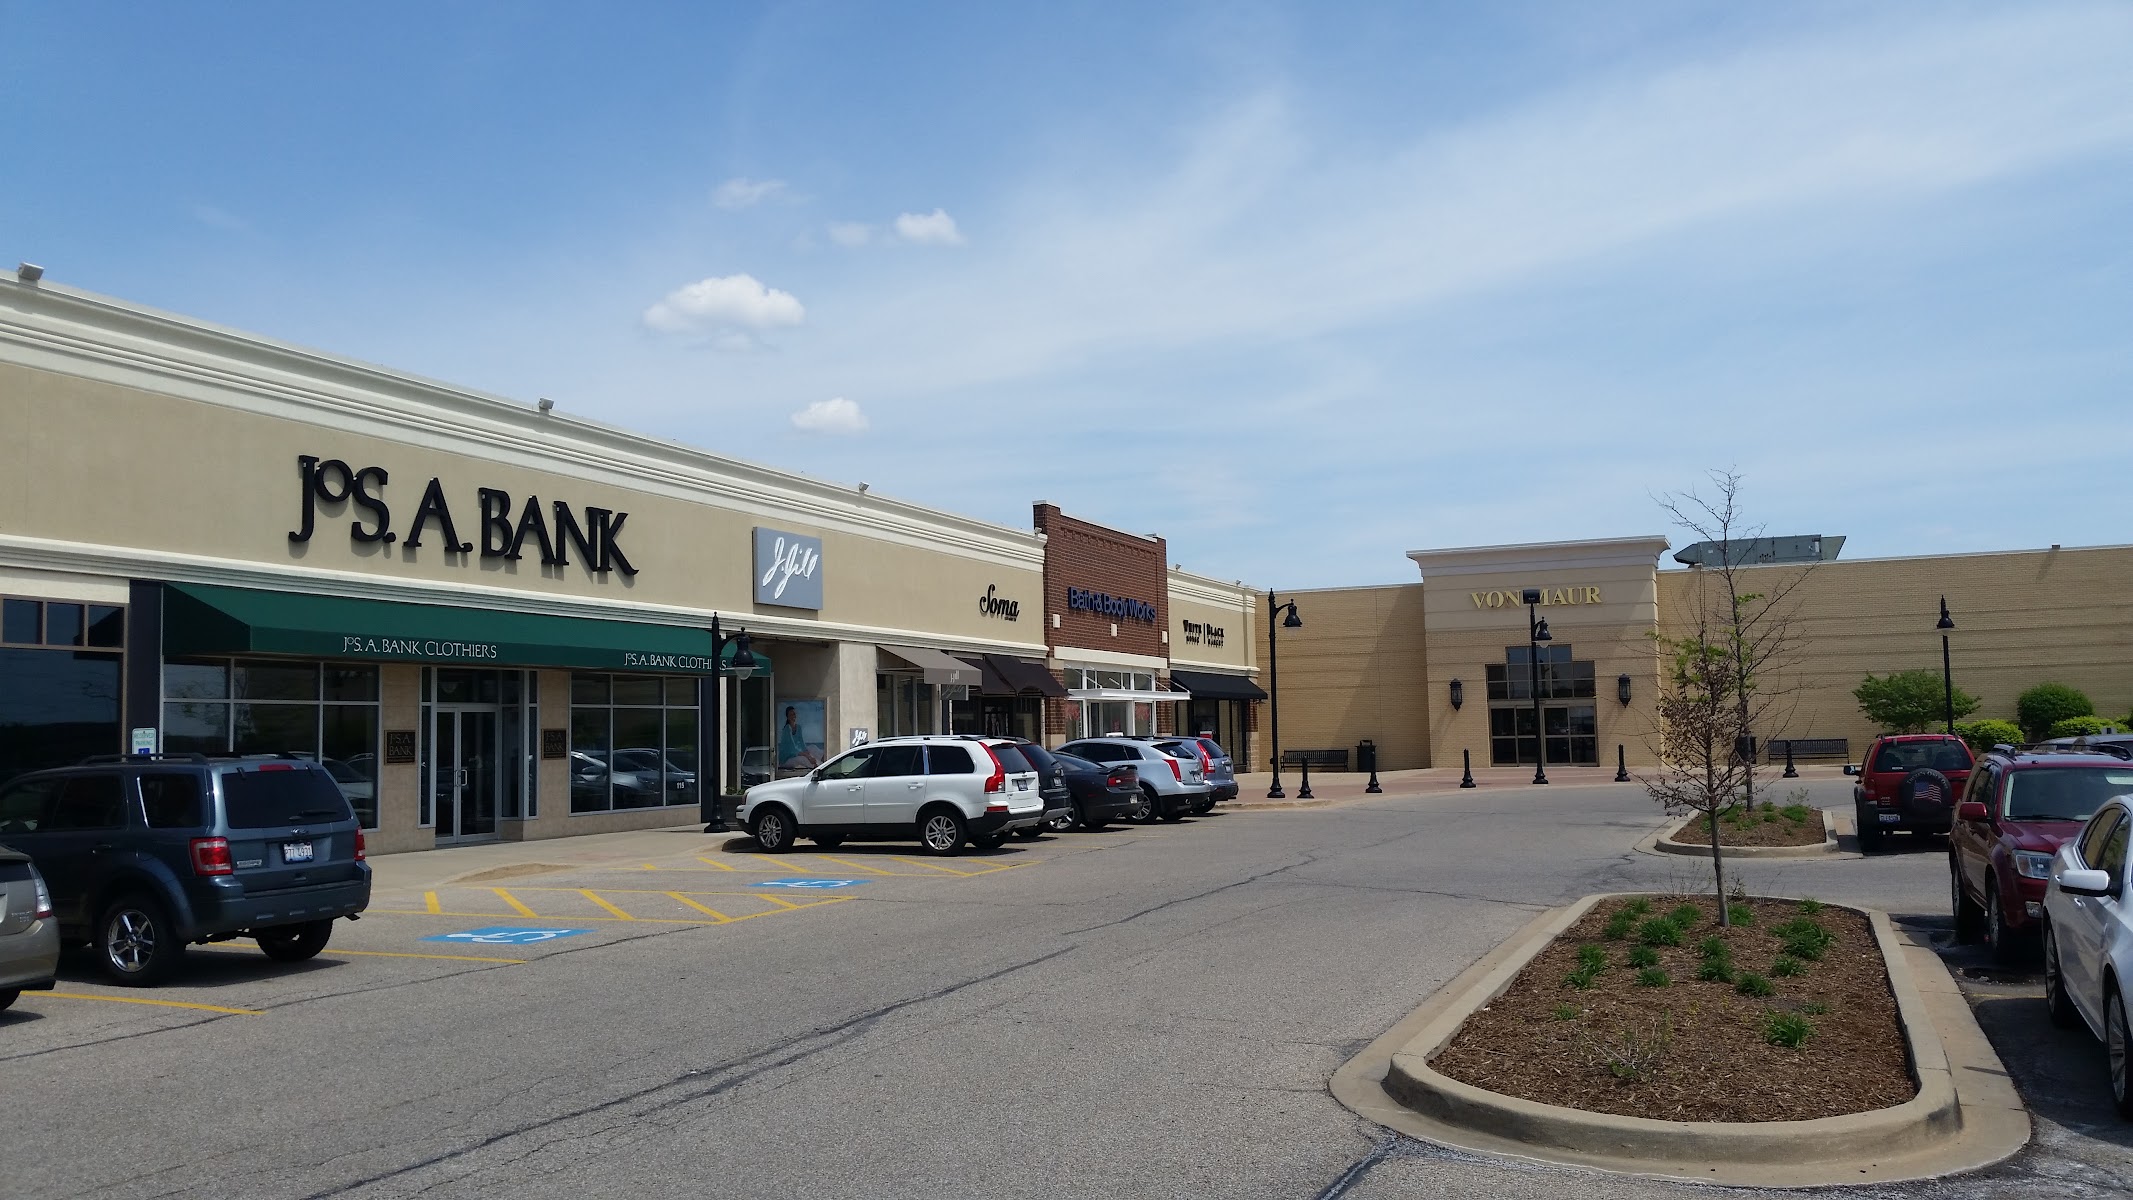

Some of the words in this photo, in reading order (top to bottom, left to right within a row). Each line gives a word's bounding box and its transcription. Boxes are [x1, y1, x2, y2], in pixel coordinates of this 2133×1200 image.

[402, 477, 473, 552] A.
[478, 487, 640, 575] BANK
[980, 584, 1020, 616] Soma
[1068, 587, 1095, 610] Bath
[1095, 593, 1104, 612] &
[1103, 594, 1128, 620] Body
[1126, 597, 1157, 621] Works
[1470, 590, 1521, 608] VON
[365, 639, 380, 652] A.
[382, 639, 422, 655] BANK
[424, 641, 498, 658] CLOTHIERS
[638, 654, 650, 666] A.
[650, 654, 677, 668] BANK
[678, 656, 727, 671] CLOTHIS
